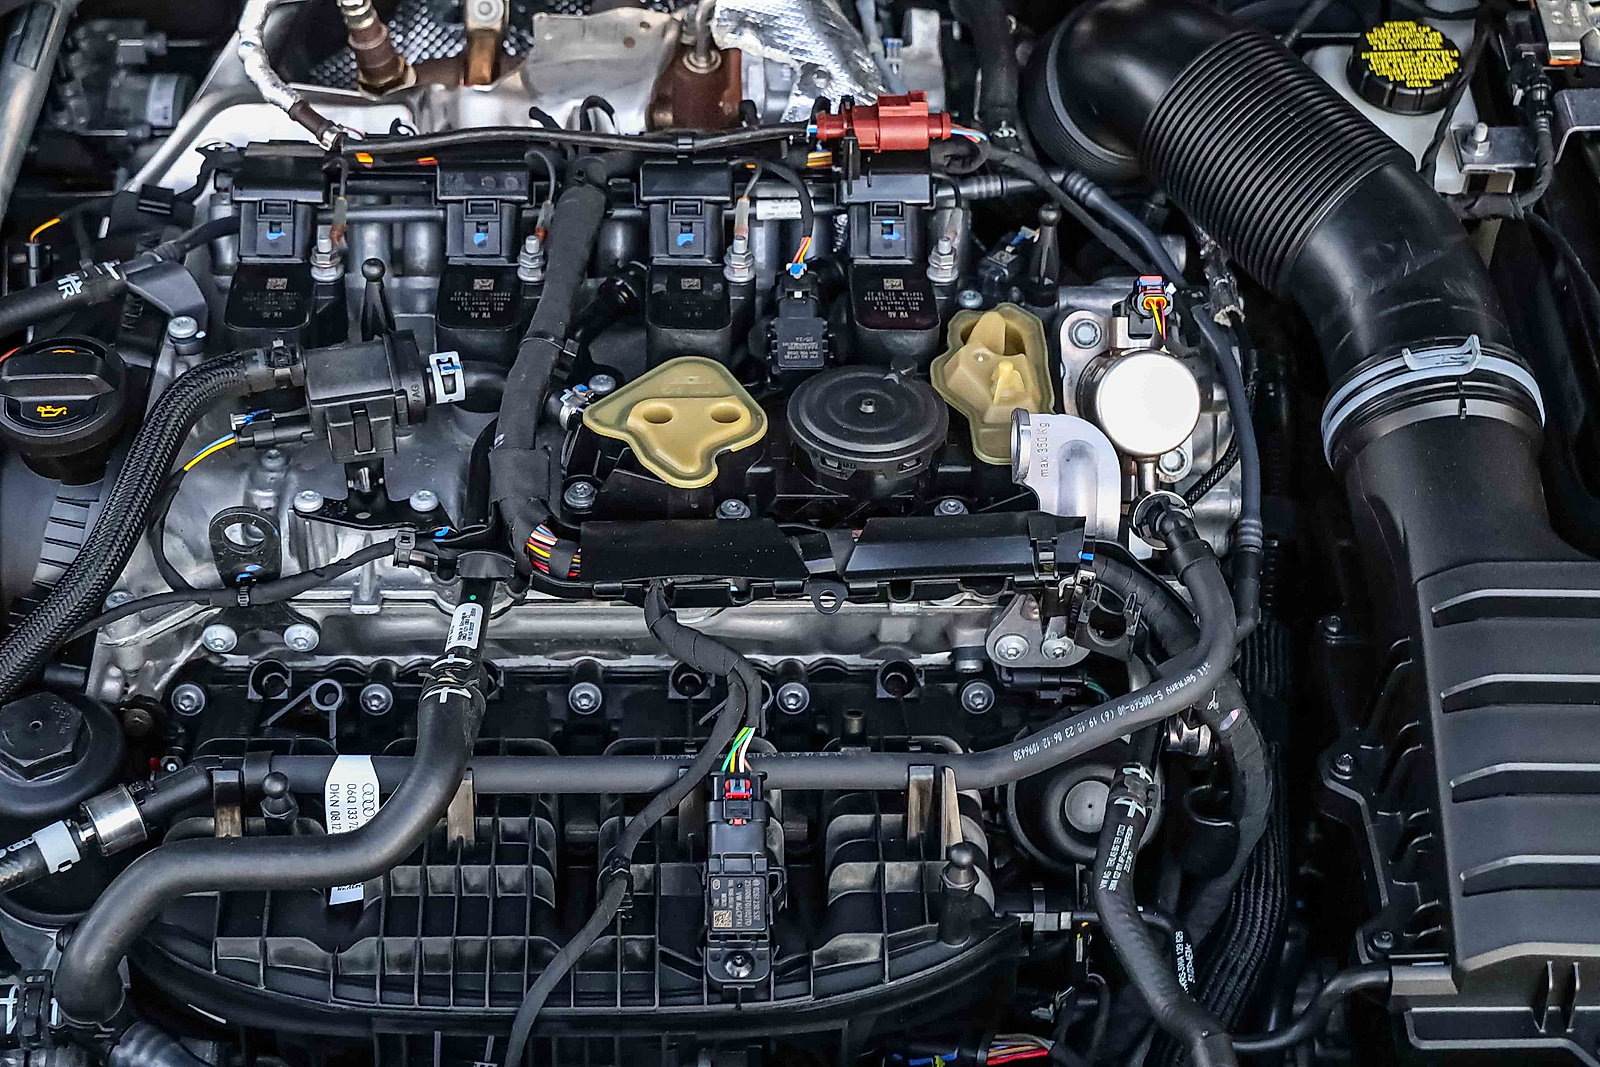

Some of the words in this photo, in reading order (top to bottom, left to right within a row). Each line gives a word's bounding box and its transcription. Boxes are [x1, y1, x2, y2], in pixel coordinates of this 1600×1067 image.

[1040, 456, 1049, 477] max
[1166, 673, 1197, 695] Germany
[1042, 732, 1063, 747] 06:12
[329, 783, 340, 808] DKN
[346, 783, 357, 804] 06Q
[346, 807, 358, 820] 133
